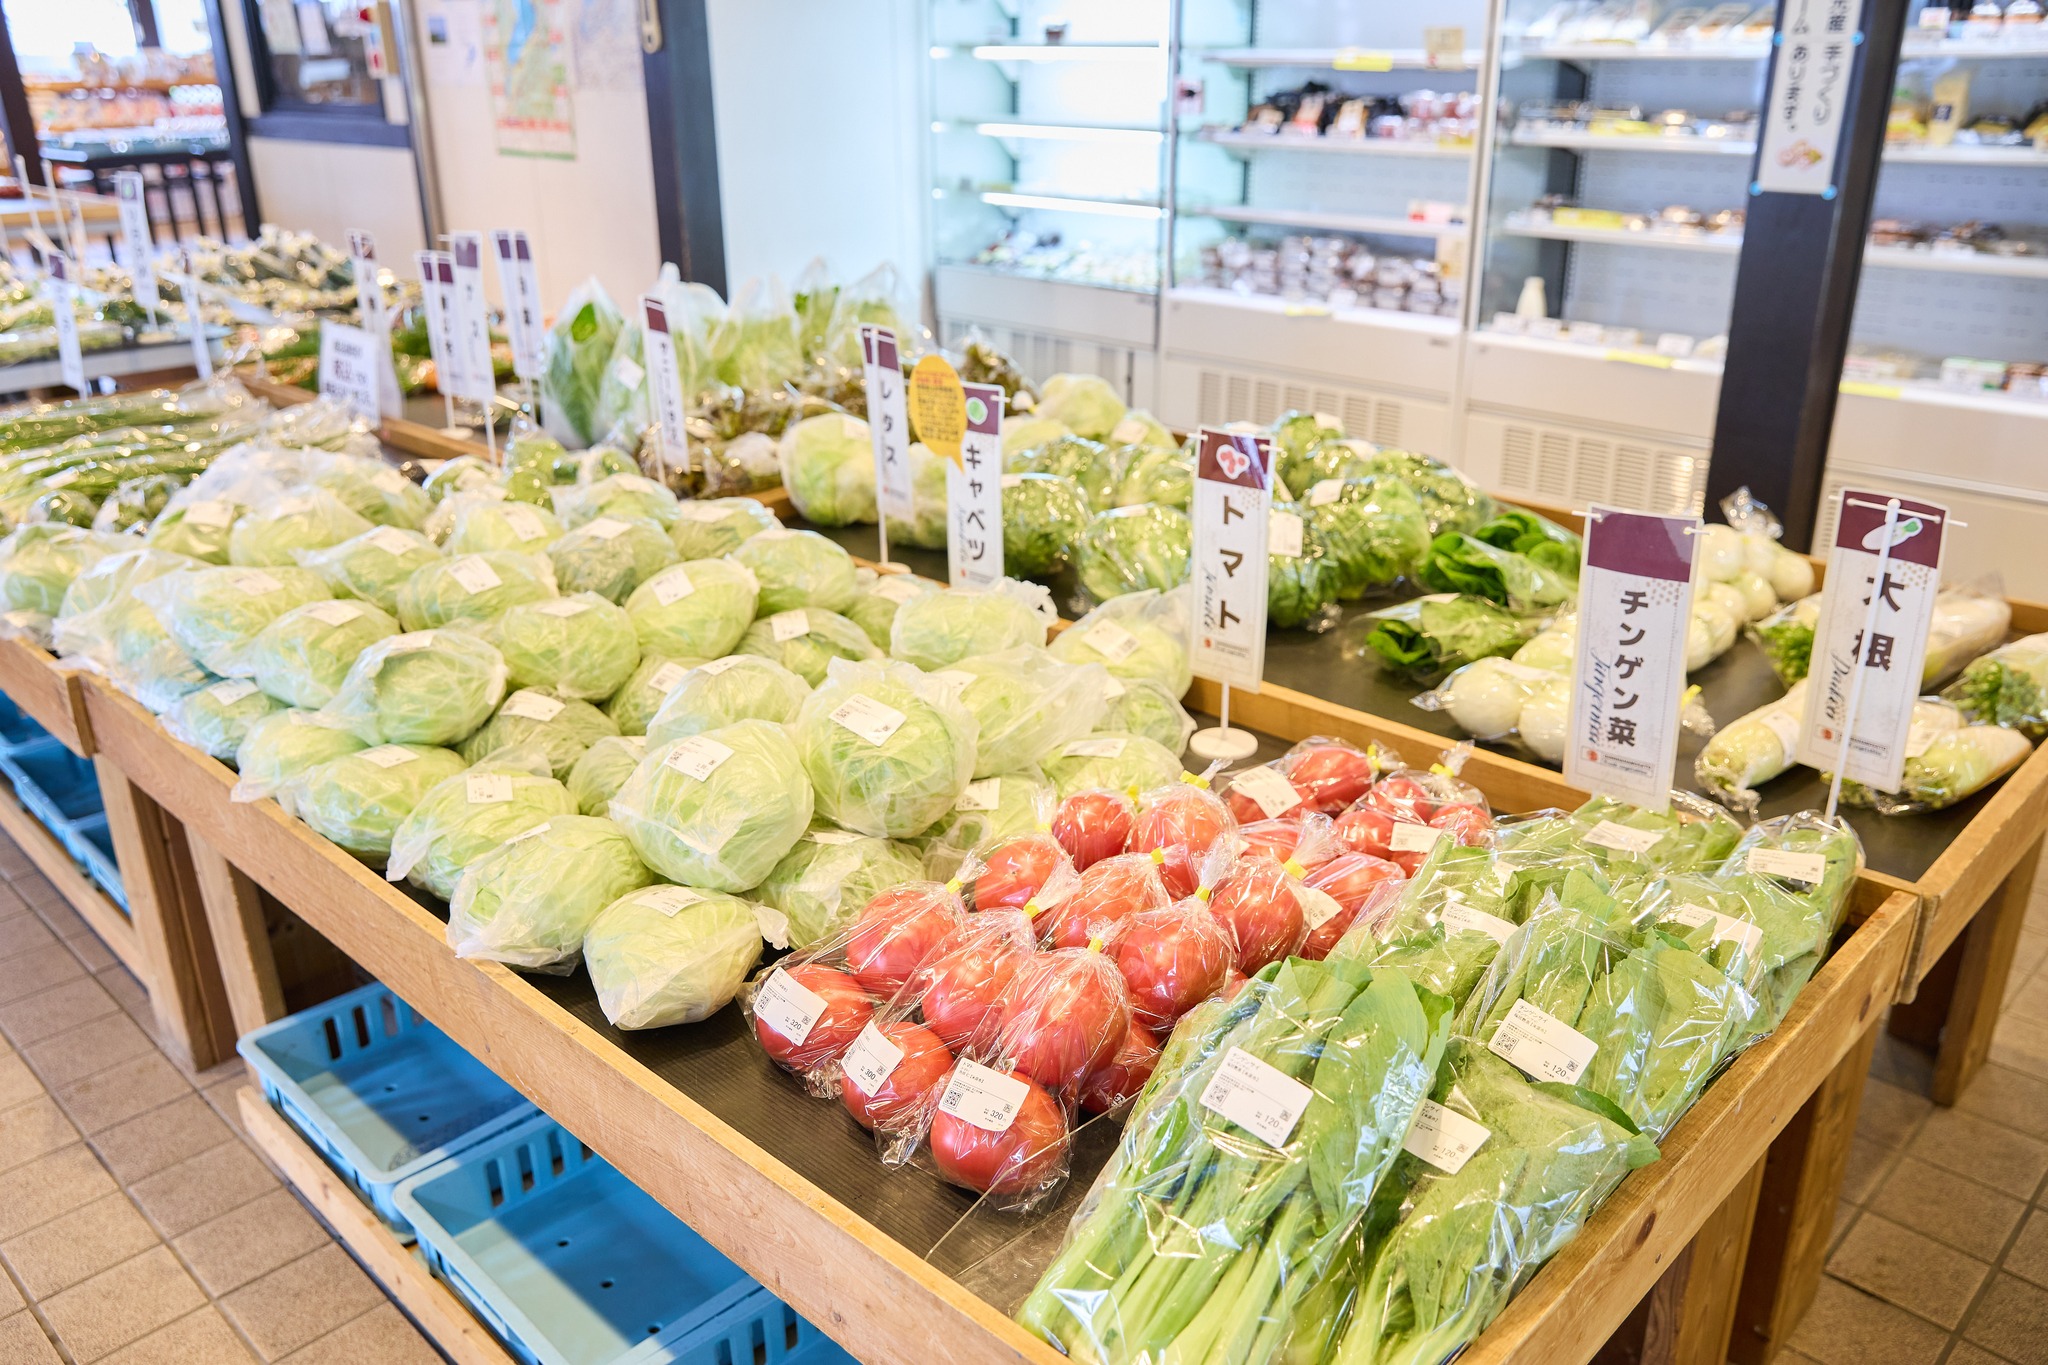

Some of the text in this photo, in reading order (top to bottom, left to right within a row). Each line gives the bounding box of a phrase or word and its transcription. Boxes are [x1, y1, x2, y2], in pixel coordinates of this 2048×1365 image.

[881, 379, 898, 465] レタス
[965, 443, 985, 562] キャベツ
[1219, 495, 1245, 629] トマト
[1851, 571, 1905, 672] 大根
[1607, 589, 1649, 747] チンゲン菜
[1519, 1005, 1547, 1023] チンゲンサイ
[790, 1019, 802, 1030] 320
[865, 1068, 876, 1080] 300
[1552, 1064, 1567, 1078] 120
[990, 1109, 1004, 1121] 320
[1265, 1115, 1280, 1128] 120
[1441, 1147, 1456, 1158] 120
